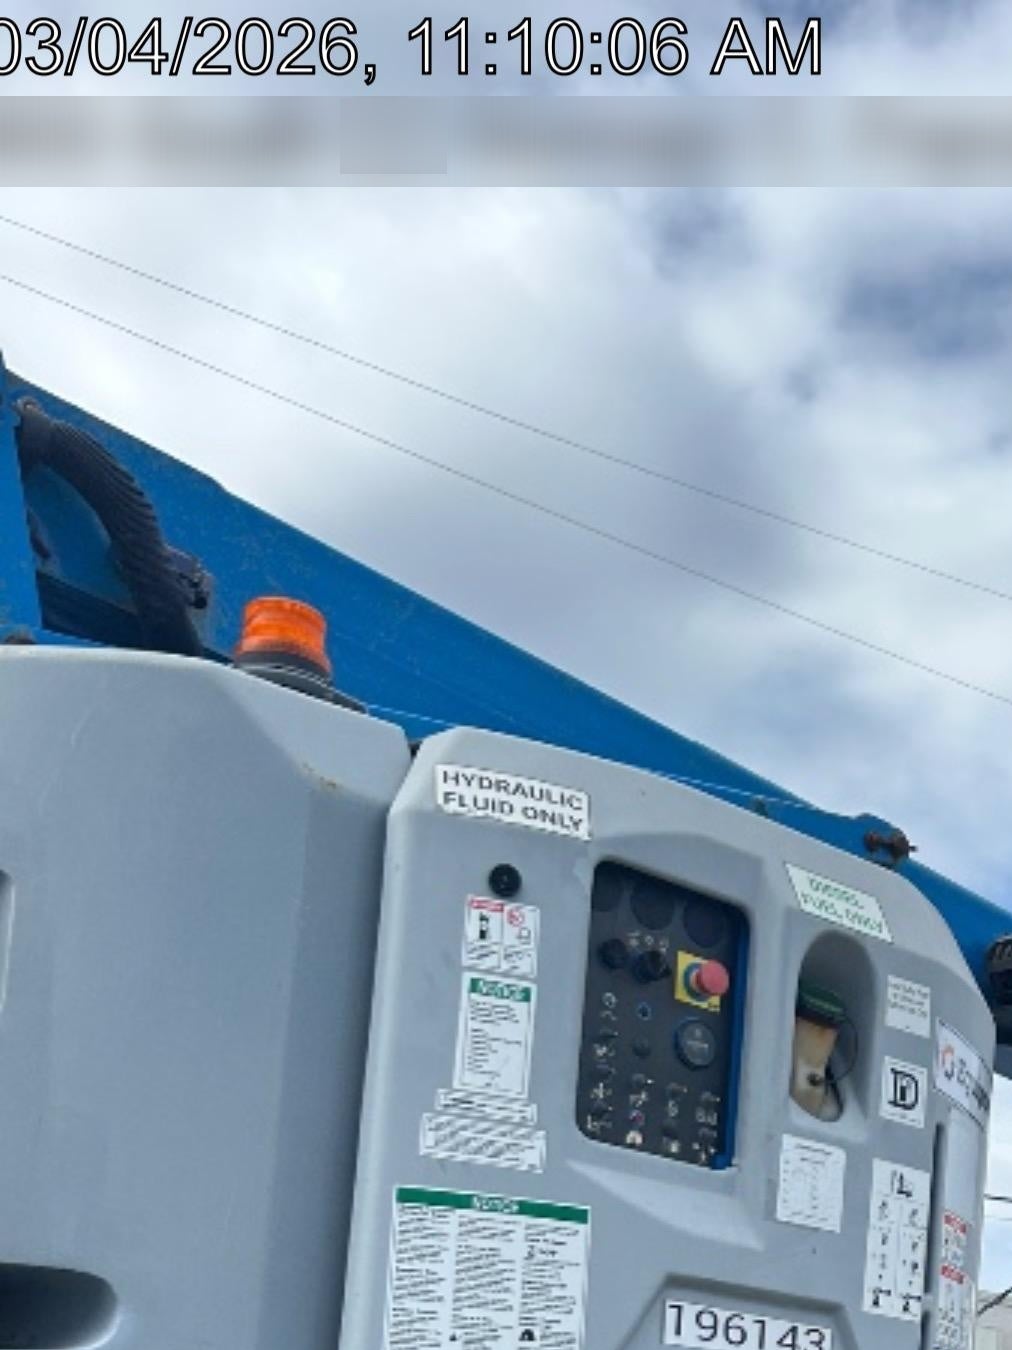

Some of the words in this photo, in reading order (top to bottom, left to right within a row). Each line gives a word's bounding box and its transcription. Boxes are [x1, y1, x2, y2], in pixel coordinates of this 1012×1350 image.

[442, 770, 583, 811] HYDRAULIC
[442, 791, 515, 815] FLUID
[521, 806, 583, 832] ONLY
